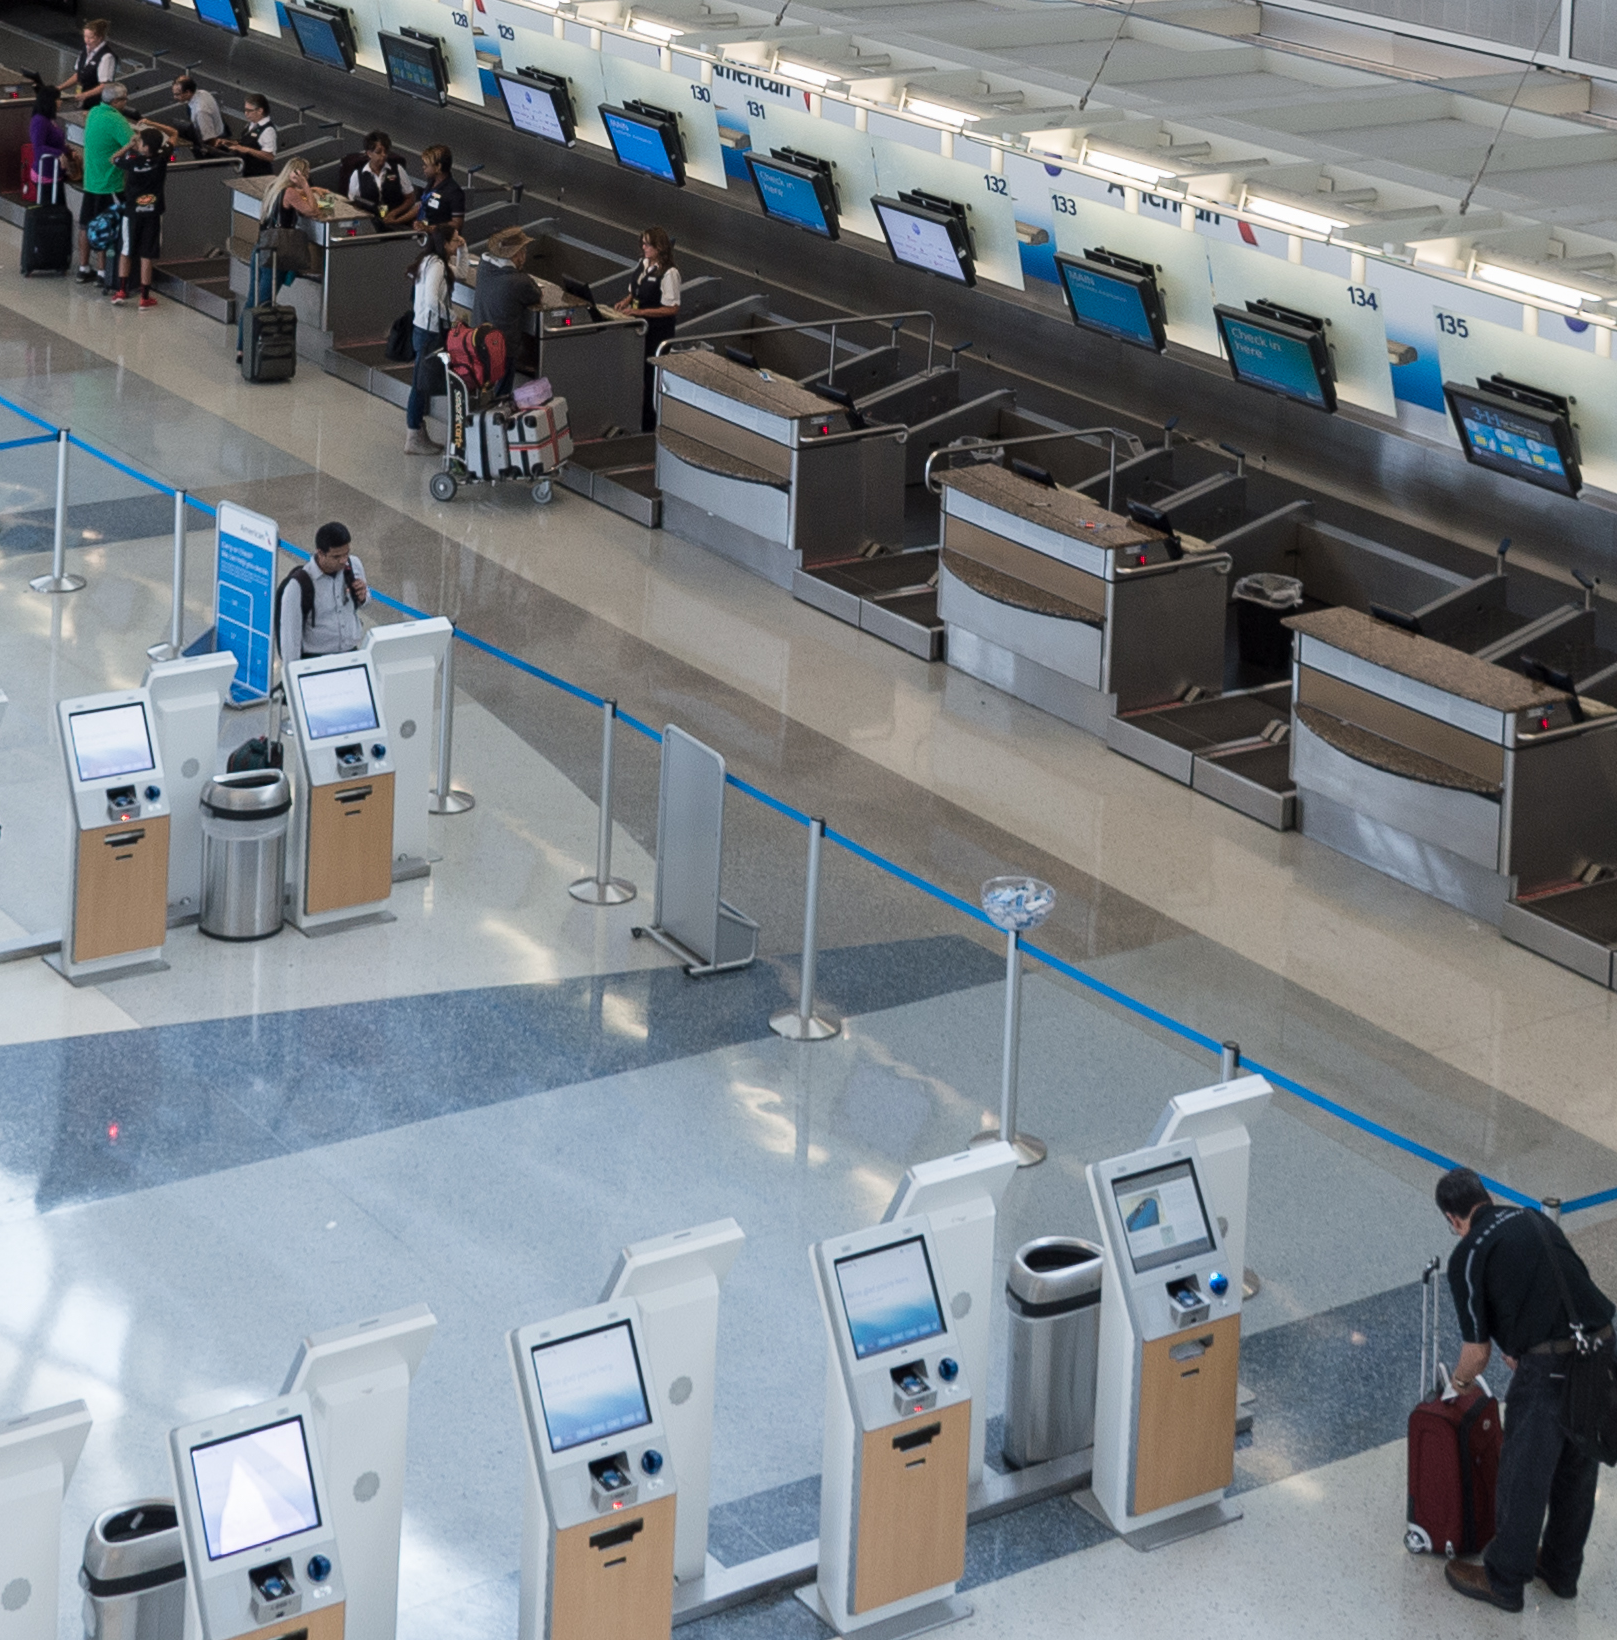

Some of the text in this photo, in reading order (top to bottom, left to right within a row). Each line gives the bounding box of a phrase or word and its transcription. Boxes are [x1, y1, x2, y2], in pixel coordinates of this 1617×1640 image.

[451, 11, 469, 28] 128
[497, 23, 515, 41] 129
[690, 84, 711, 103] 130
[746, 100, 766, 120] 131
[759, 170, 785, 187] Check
[983, 174, 1009, 197] 132
[1051, 194, 1078, 216] 133
[1067, 269, 1096, 287] MAIN
[1347, 286, 1379, 311] 134
[1436, 312, 1470, 339] 135
[1232, 326, 1282, 352] Check in
[1235, 340, 1267, 360] here.
